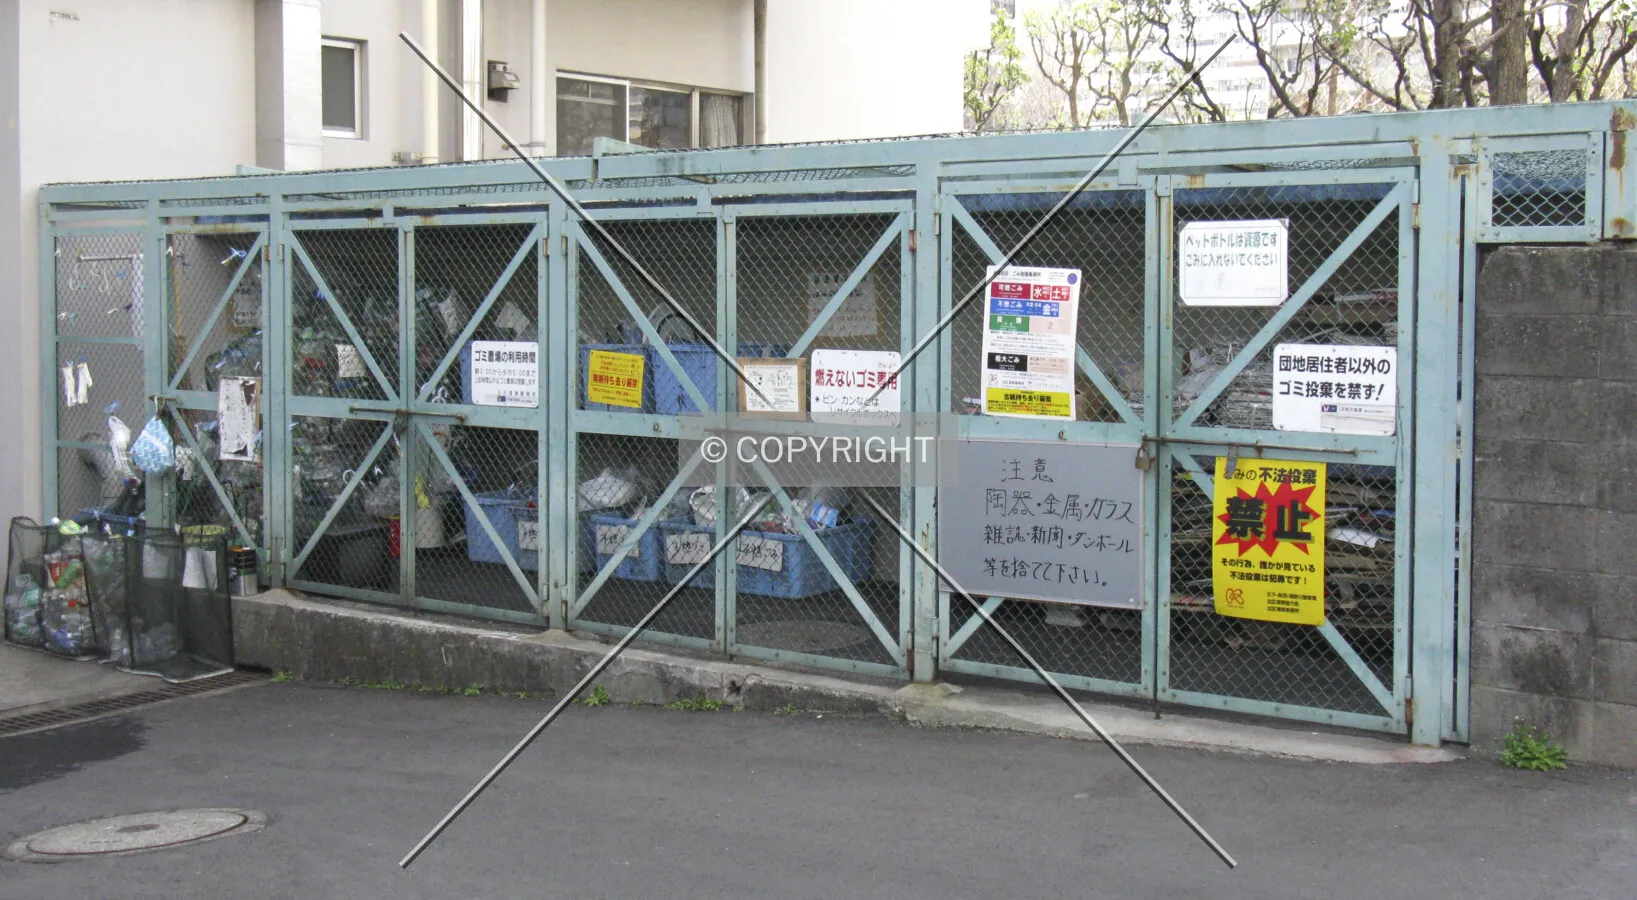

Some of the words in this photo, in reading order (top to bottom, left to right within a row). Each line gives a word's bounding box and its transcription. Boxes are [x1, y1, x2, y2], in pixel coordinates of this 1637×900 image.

[1034, 287, 1042, 298] 水
[1052, 289, 1061, 299] 土
[1043, 303, 1051, 315] 金
[1279, 355, 1391, 375] 団地居住者以外の
[1001, 458, 1054, 483] 注意
[1226, 496, 1314, 543] 禁止
